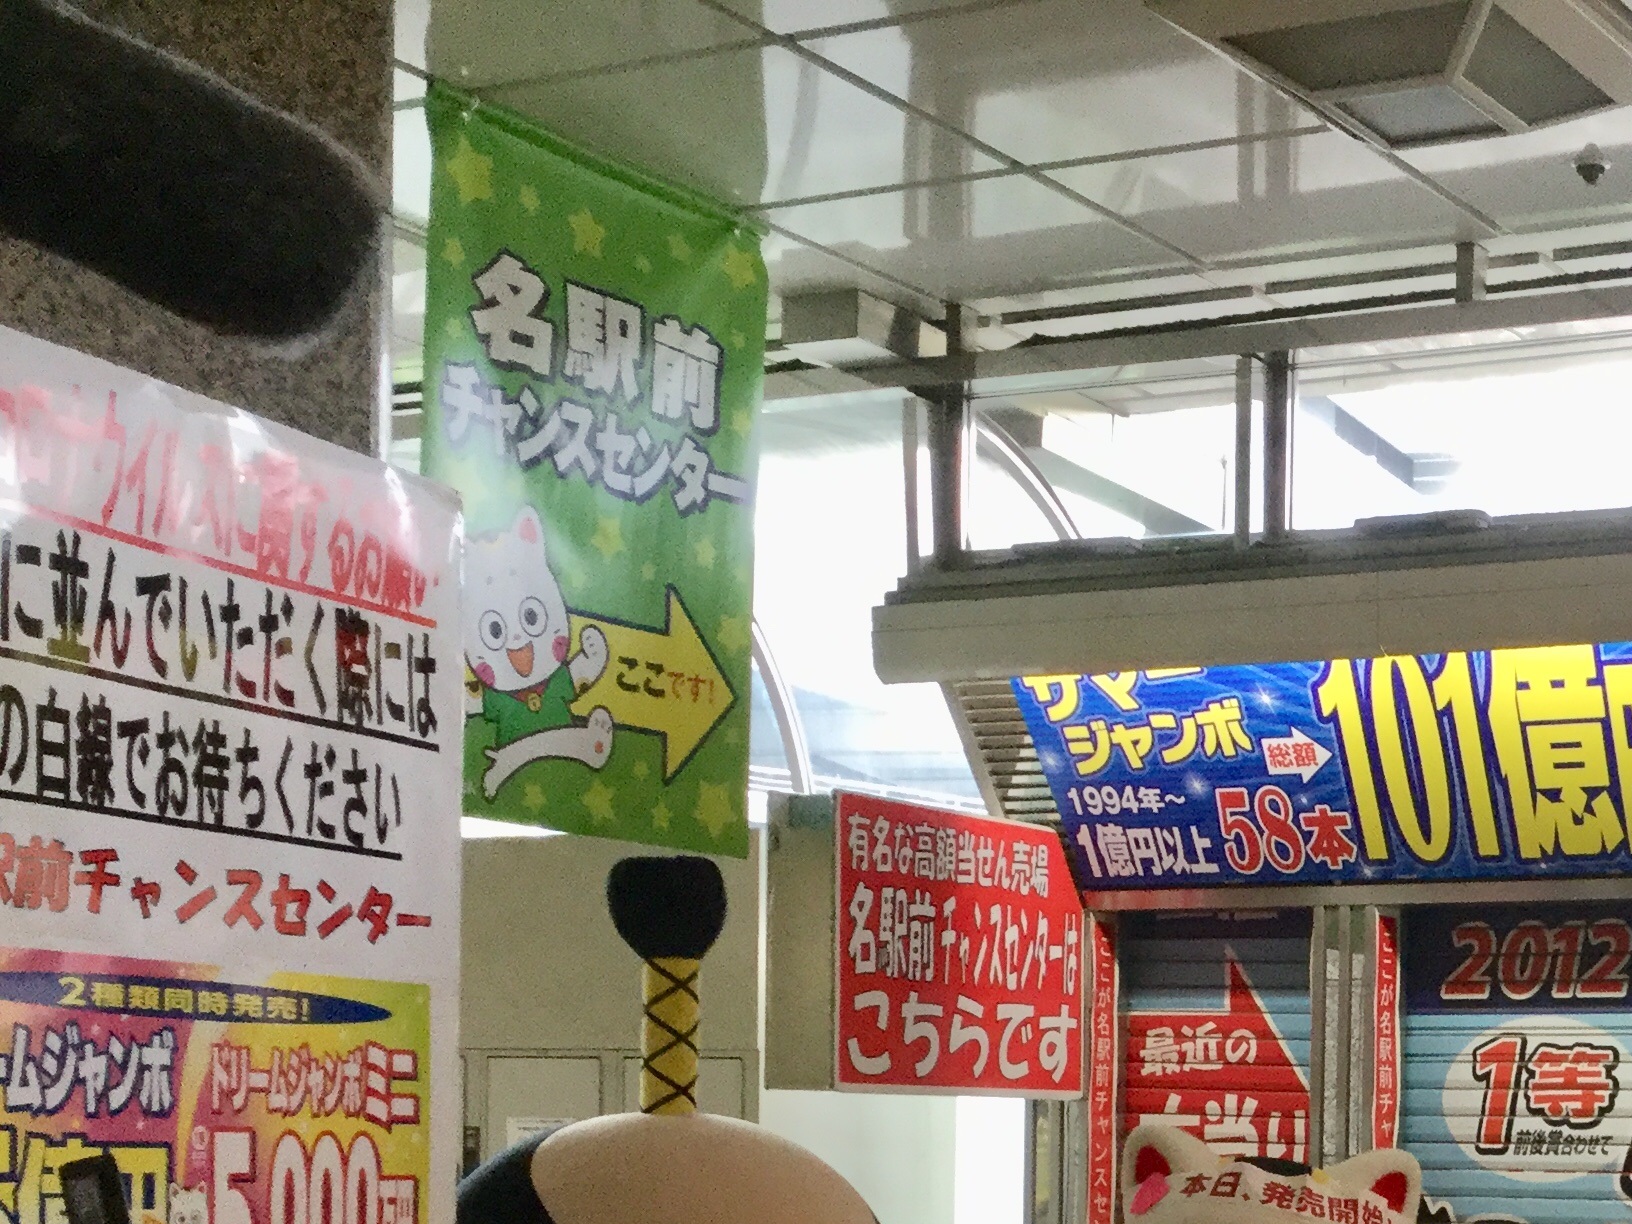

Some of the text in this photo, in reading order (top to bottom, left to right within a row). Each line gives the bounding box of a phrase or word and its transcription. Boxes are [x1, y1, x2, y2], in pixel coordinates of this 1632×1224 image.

[471, 249, 723, 436] 名駅前
[441, 360, 752, 516] チャンスセンター
[1063, 698, 1253, 776] ジャンボ
[1266, 741, 1319, 769] 総額
[847, 811, 1049, 898] 有名な高額当せん売場
[1076, 785, 1358, 878] 1億円以上 58本
[847, 881, 1079, 996] 名駅前チャンスセンターは
[0, 1021, 175, 1116] ムジャンボ
[846, 988, 1079, 1083] こちらです
[1139, 1020, 1258, 1077] 最近の
[1475, 1035, 1617, 1151] 1等
